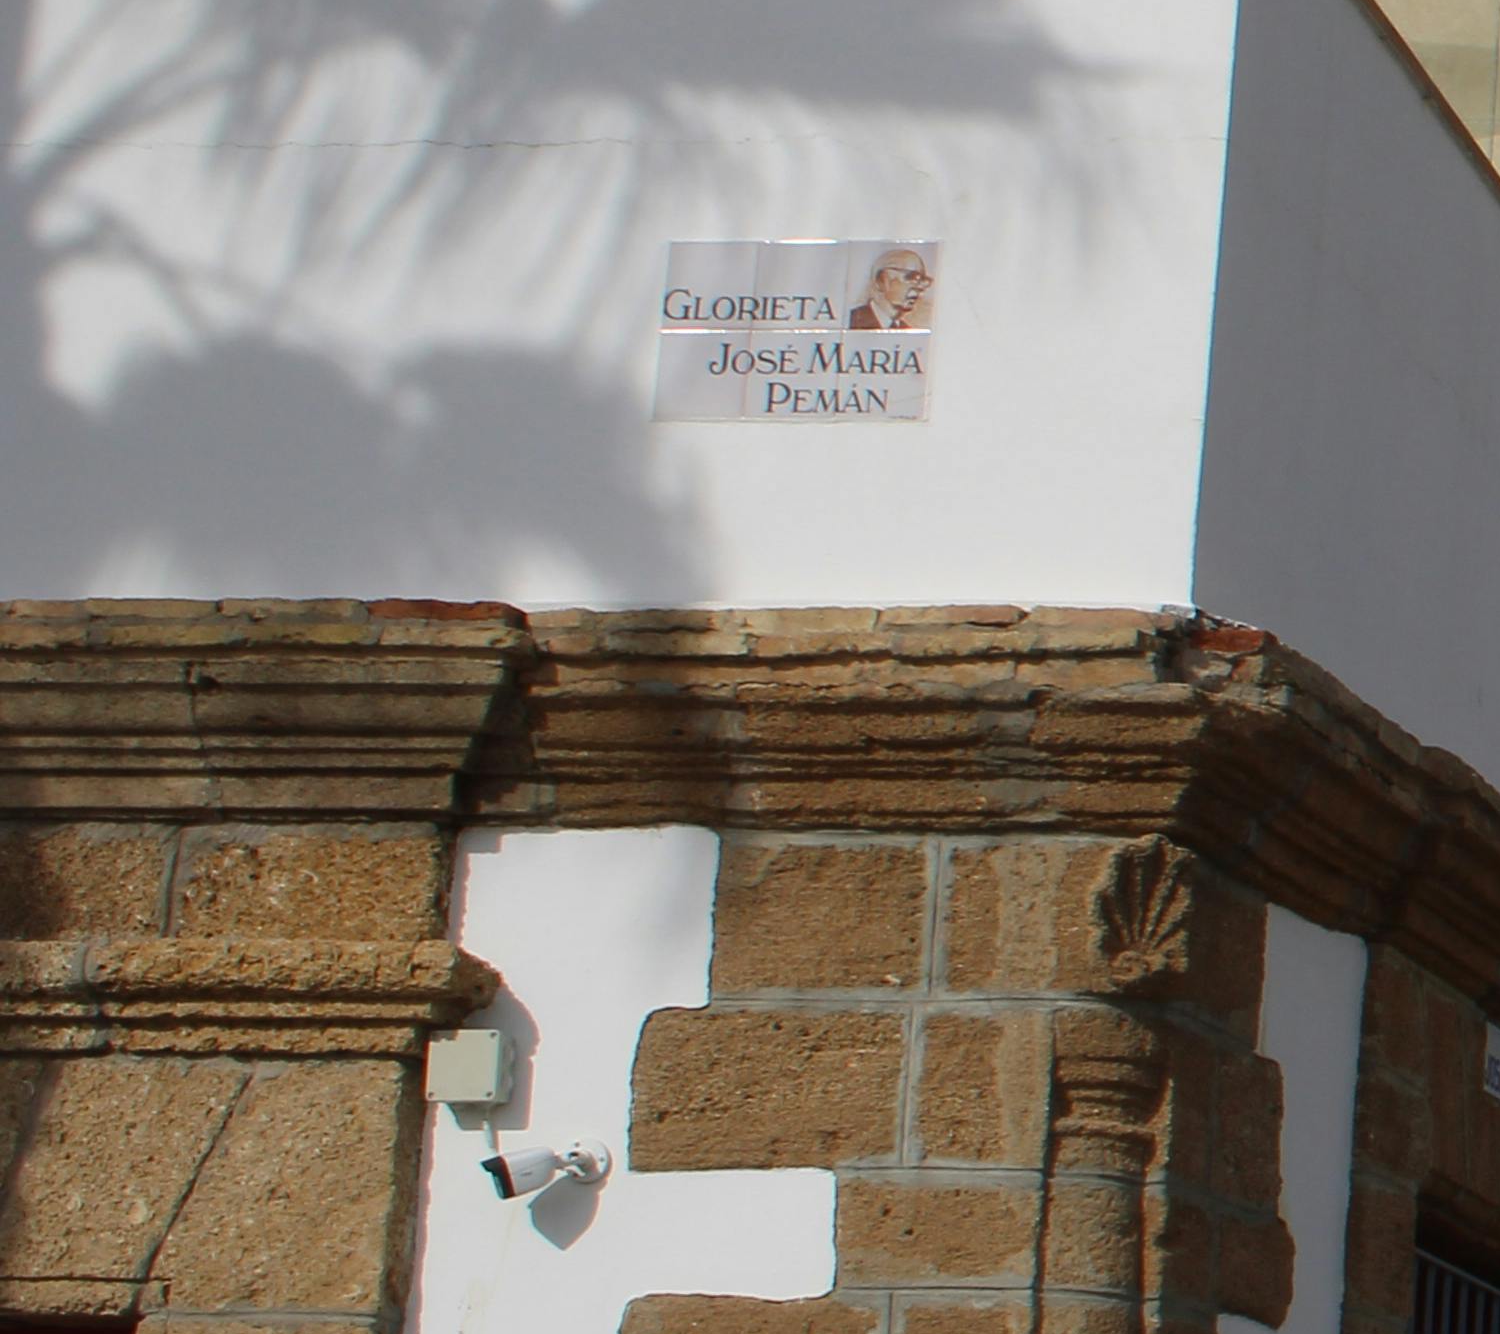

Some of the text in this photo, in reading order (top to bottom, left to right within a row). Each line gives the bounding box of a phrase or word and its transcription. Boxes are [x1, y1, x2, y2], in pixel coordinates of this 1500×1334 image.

[664, 289, 836, 321] GLORIETA
[709, 343, 924, 375] JOSÉ MARÍA
[765, 382, 889, 413] PEMÁN
